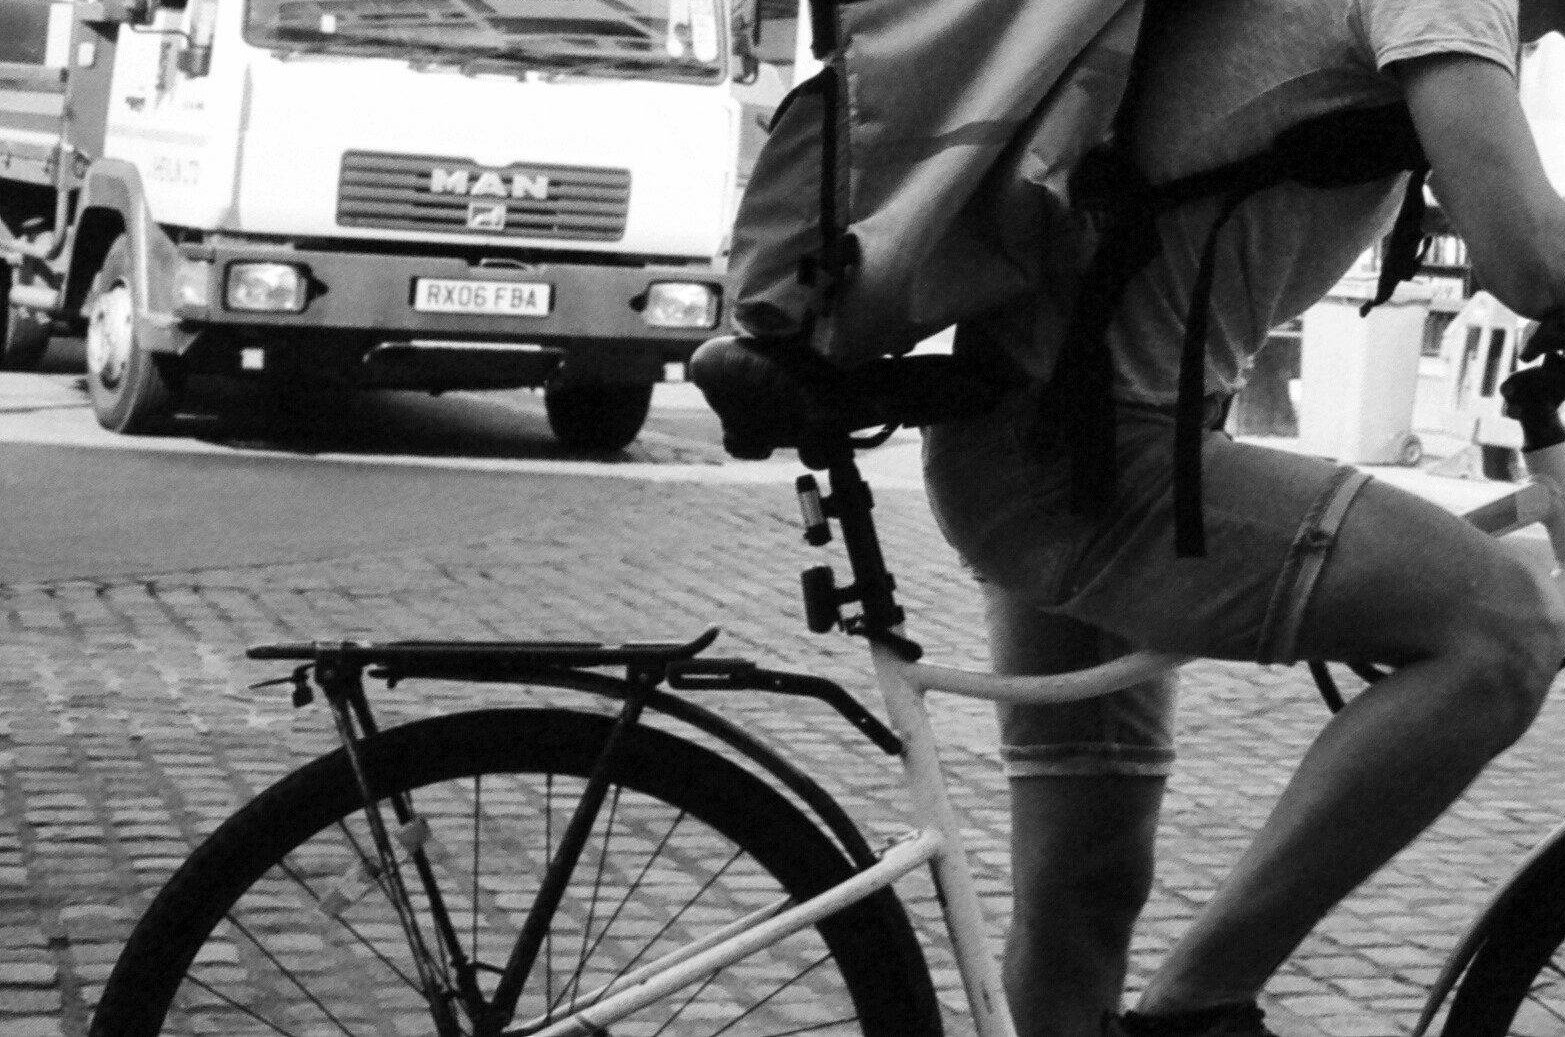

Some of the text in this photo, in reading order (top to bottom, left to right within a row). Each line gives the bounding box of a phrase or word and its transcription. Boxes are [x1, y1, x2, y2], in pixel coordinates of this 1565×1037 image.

[430, 167, 549, 200] MAN
[426, 283, 538, 310] RX06 FBA
